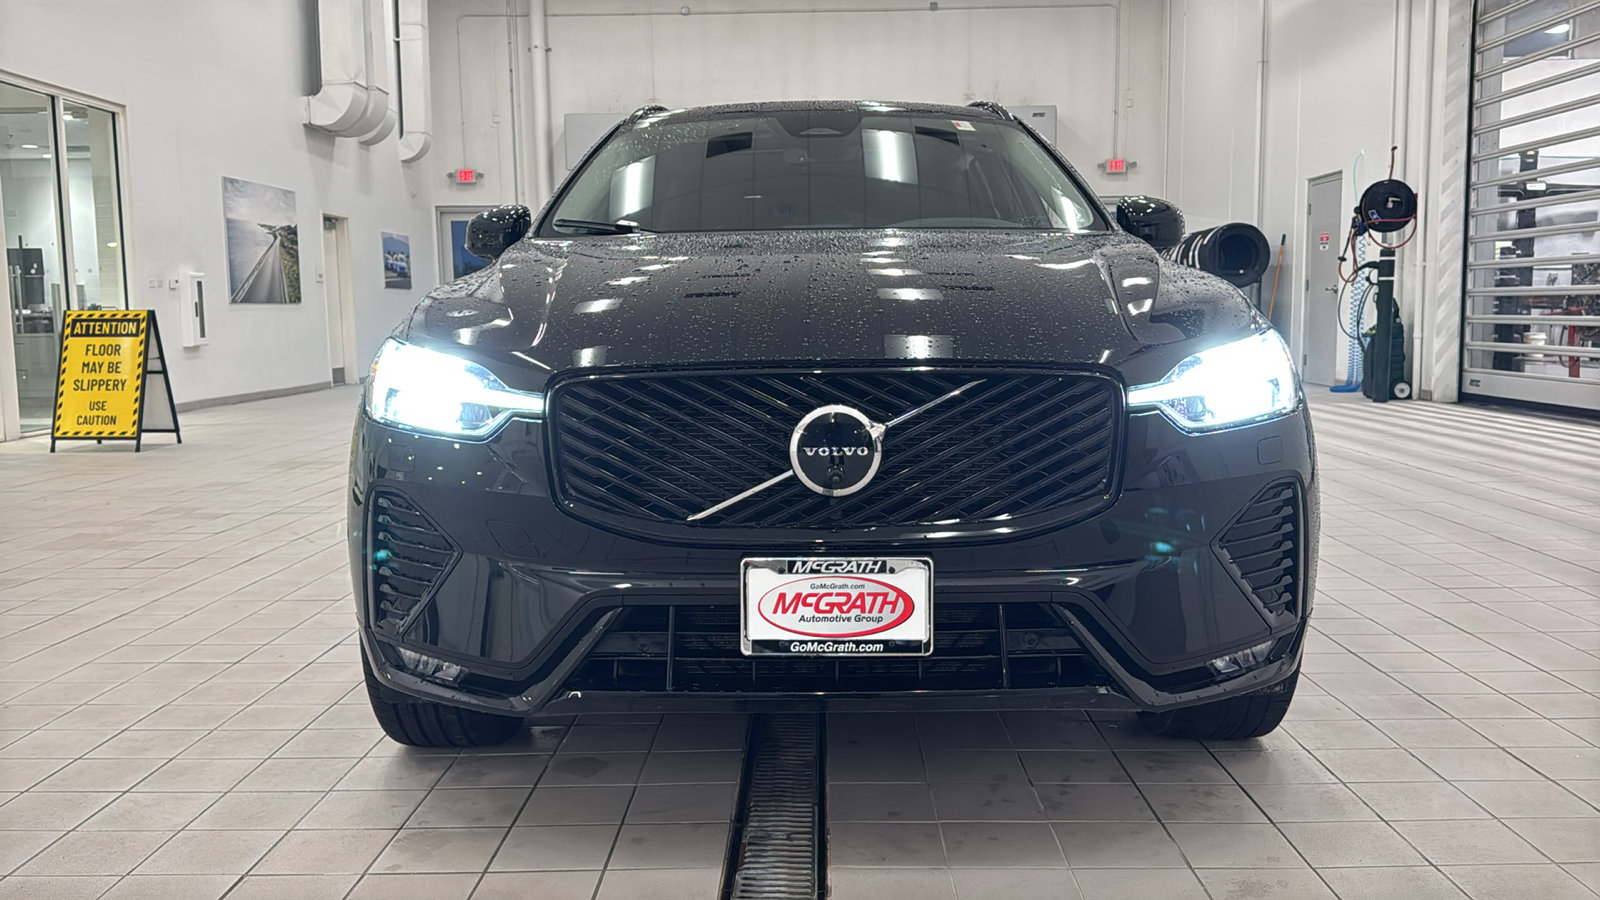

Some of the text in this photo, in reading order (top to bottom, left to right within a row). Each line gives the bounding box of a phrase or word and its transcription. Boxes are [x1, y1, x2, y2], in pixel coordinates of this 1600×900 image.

[73, 321, 137, 335] ATTENTION
[85, 343, 122, 356] FLOOR
[81, 361, 122, 374] MAY BE
[72, 379, 127, 392] SLIPPERY
[89, 400, 107, 411] USE
[76, 415, 117, 426] CAUTION
[802, 446, 869, 456] VOLVO
[791, 560, 882, 574] McGRATH
[772, 592, 900, 615] McGRATH
[798, 614, 884, 624] Automotive Group
[790, 641, 884, 653] GoMcGrath.com
